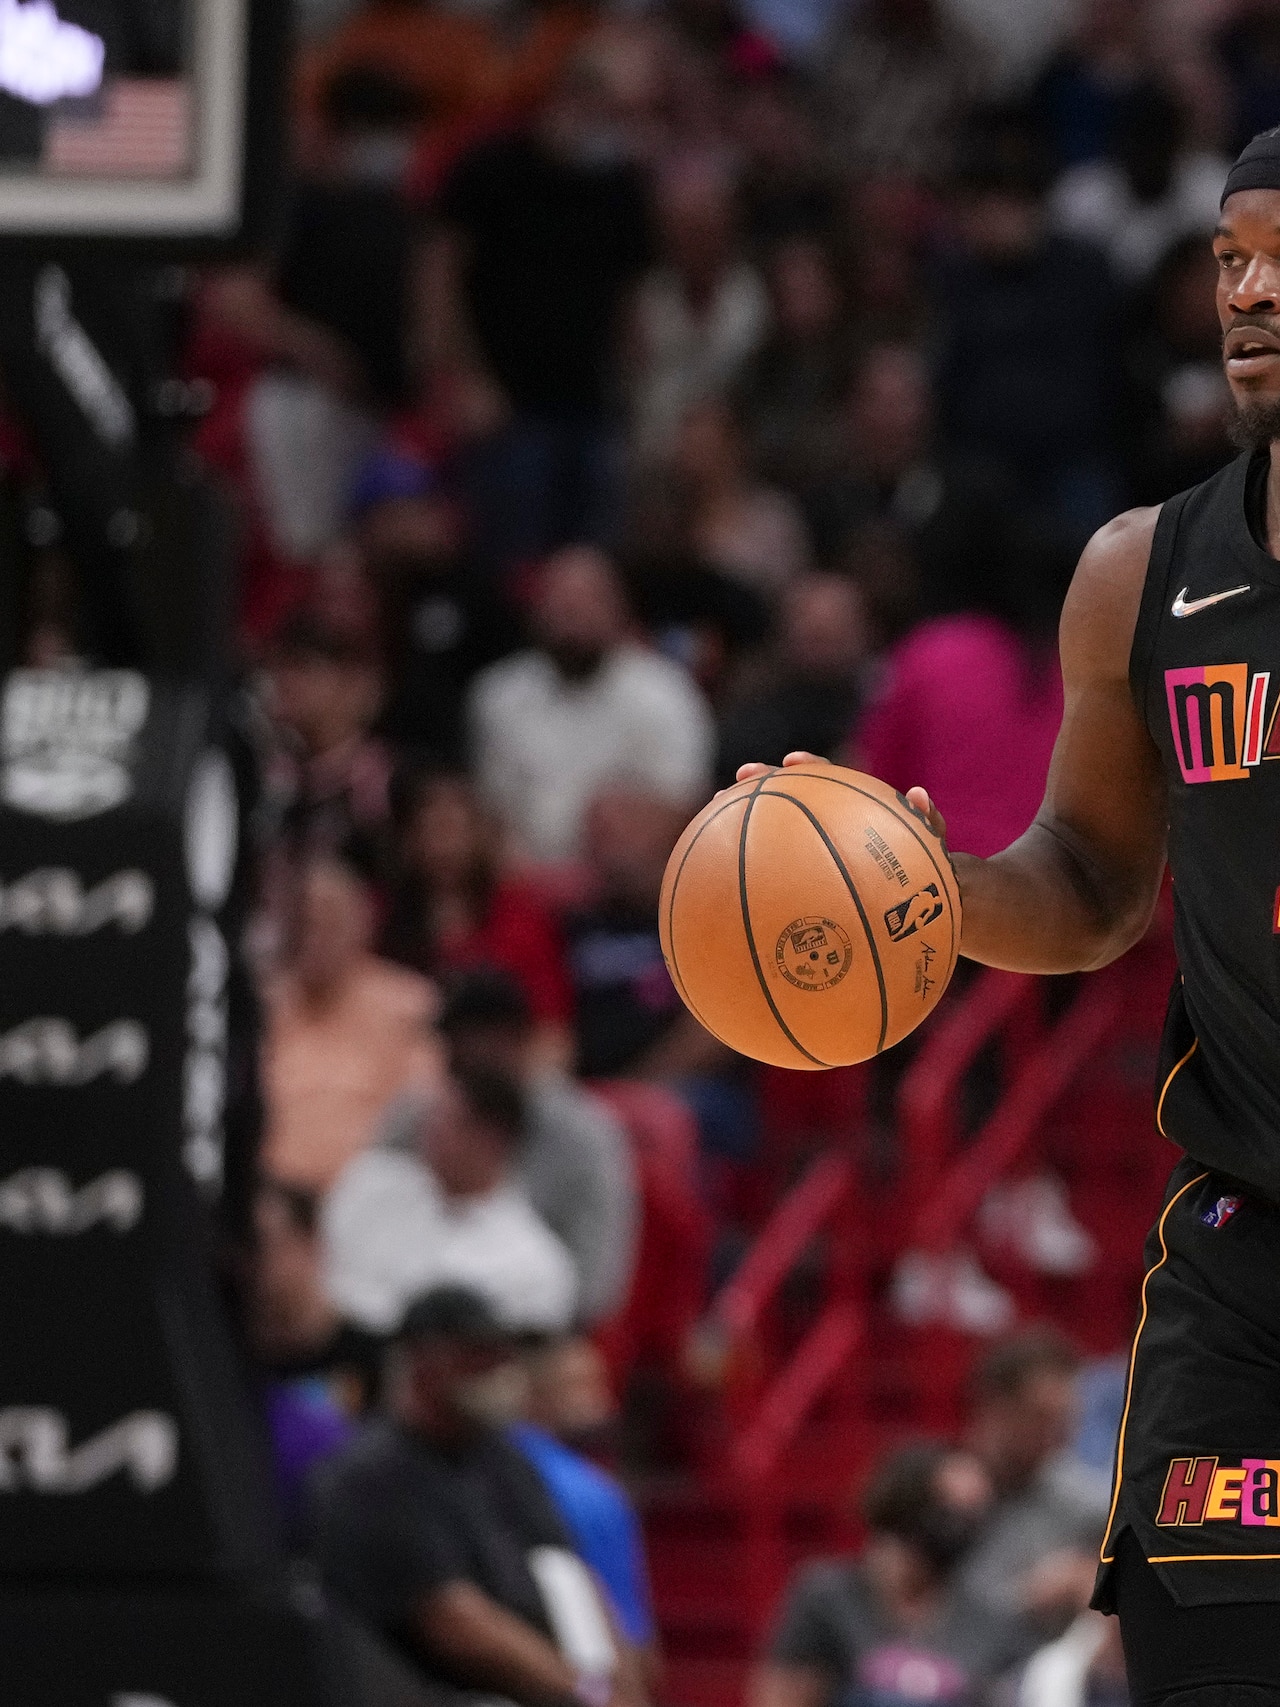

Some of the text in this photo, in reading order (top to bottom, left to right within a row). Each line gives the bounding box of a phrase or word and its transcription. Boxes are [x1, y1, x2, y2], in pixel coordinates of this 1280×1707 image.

[884, 851, 902, 871] GAME
[895, 869, 910, 888] BALL
[887, 910, 902, 931] NBA
